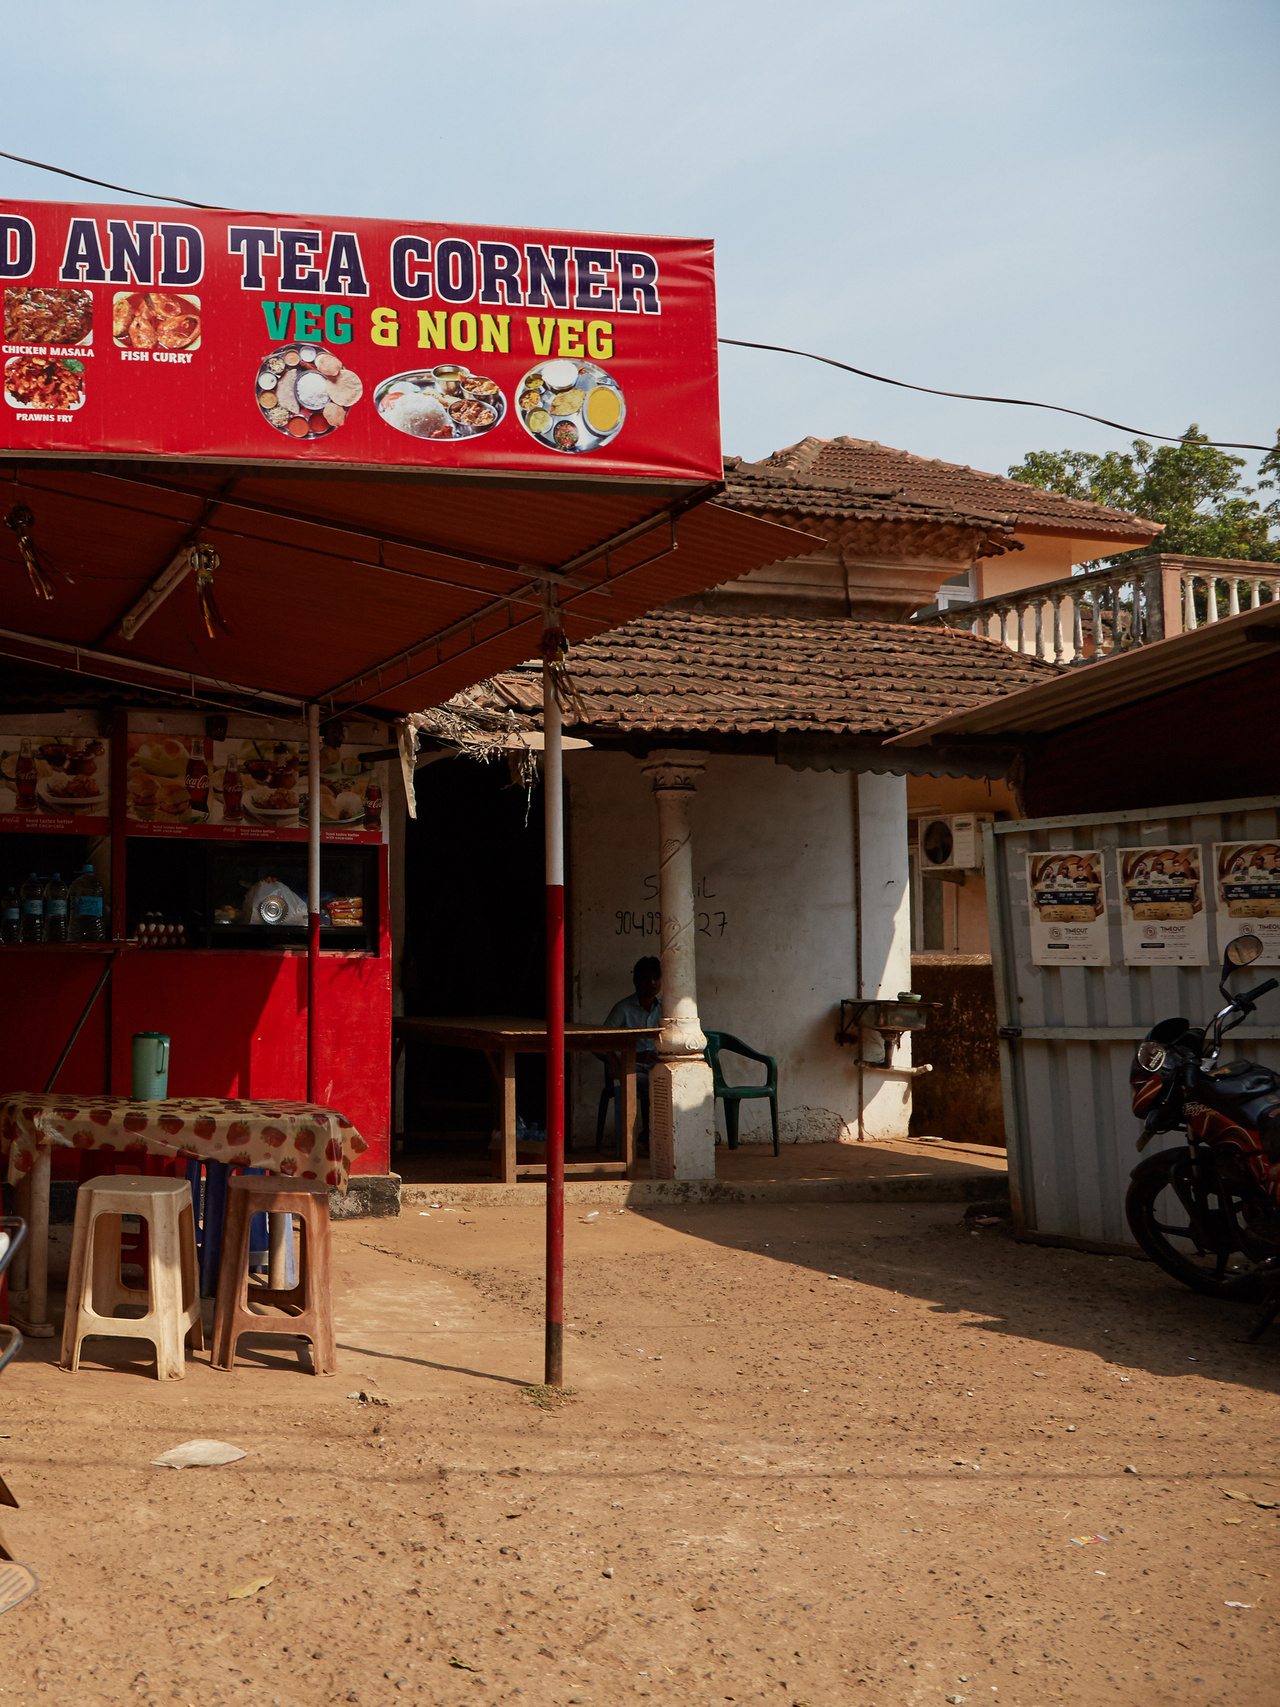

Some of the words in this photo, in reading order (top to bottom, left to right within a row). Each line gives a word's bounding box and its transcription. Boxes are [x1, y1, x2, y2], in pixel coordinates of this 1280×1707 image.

[60, 217, 205, 289] AND
[227, 225, 370, 298] TEA
[390, 234, 662, 316] CORNER
[261, 300, 353, 345] VEG
[371, 307, 400, 348] &
[417, 309, 511, 354] NON
[526, 316, 615, 361] VEG
[2, 345, 47, 356] CHICKEN
[50, 346, 95, 358] MASALA
[121, 350, 149, 362] FISH
[152, 352, 193, 364] CURRY
[16, 413, 55, 422] PRAWNS
[57, 414, 74, 423] FRY
